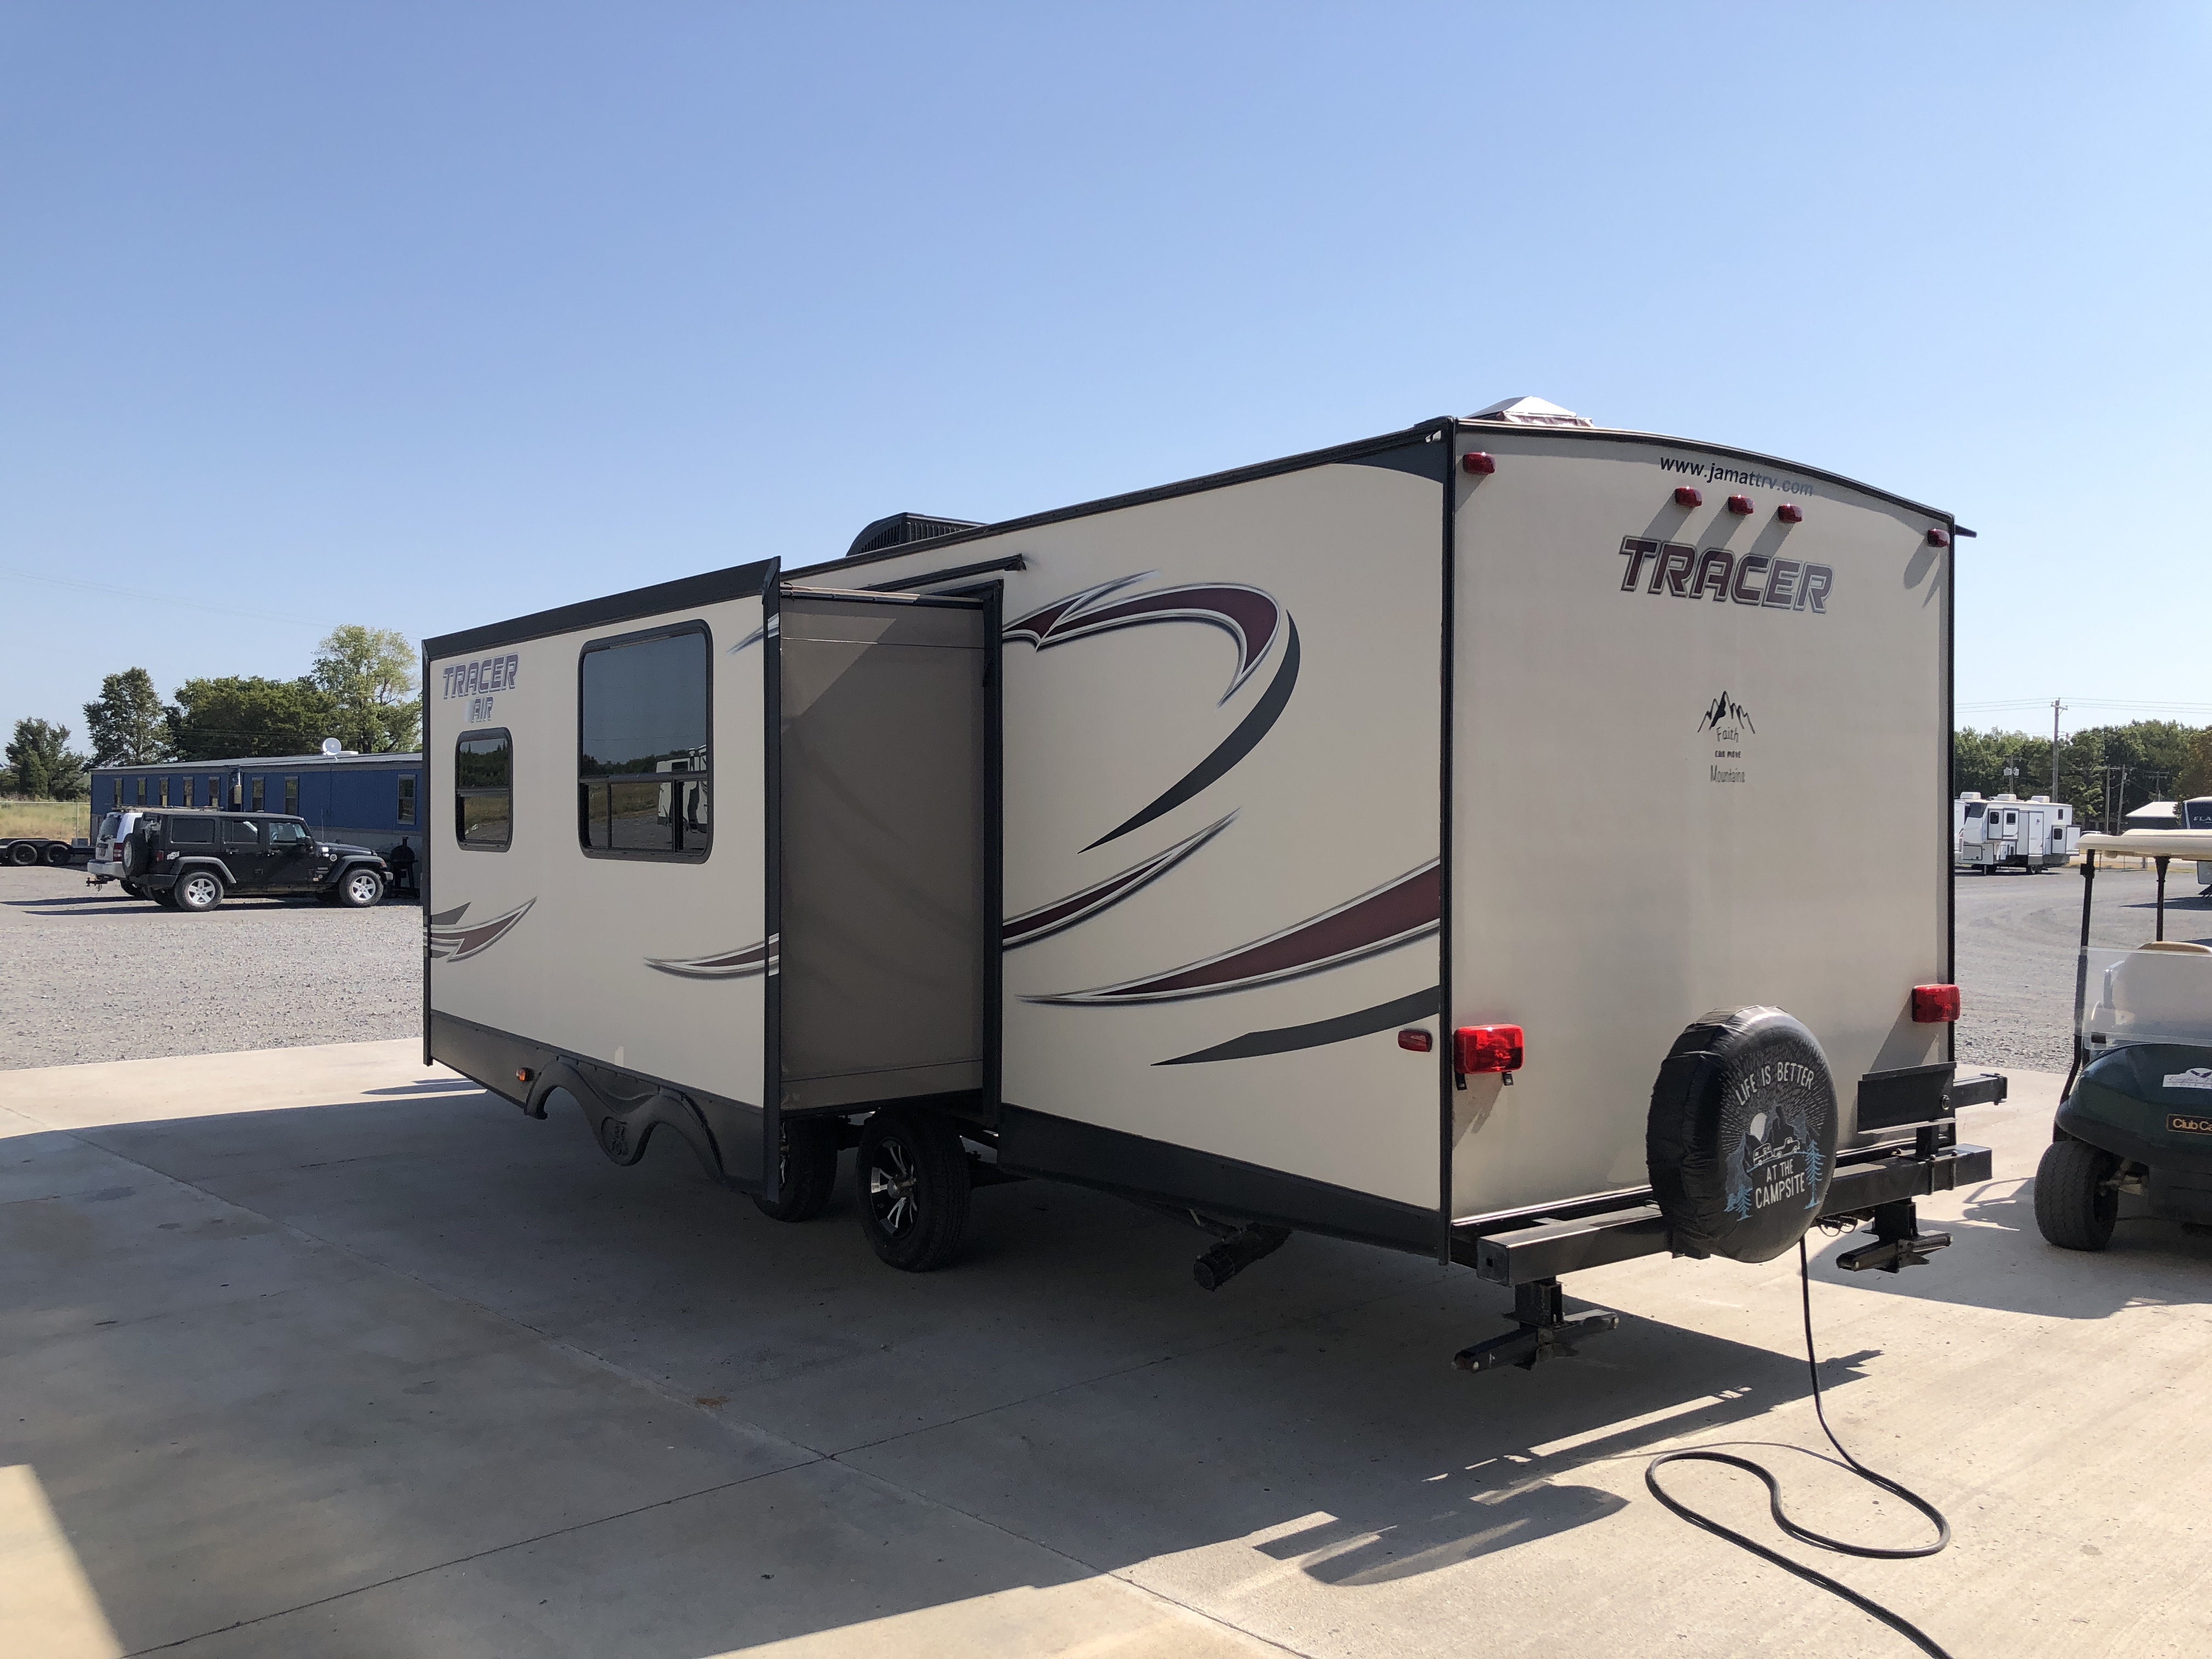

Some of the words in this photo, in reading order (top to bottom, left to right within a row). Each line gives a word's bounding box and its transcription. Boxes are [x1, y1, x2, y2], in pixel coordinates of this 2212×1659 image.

[1660, 456, 1814, 496] www.jamattrv.com
[1618, 535, 1835, 614] TRACER
[443, 652, 519, 700] TRACER
[471, 696, 494, 724] AIR
[1716, 726, 1739, 743] Faith
[1710, 765, 1745, 783] Mountains
[1735, 1073, 1757, 1105] LIFE
[1761, 1065, 1771, 1086] IS
[1777, 1061, 1814, 1090] BETTER
[2172, 1118, 2198, 1130] Club
[1767, 1164, 1778, 1183] AT
[1780, 1159, 1794, 1177] THE
[1756, 1172, 1805, 1209] CAMPSITE
